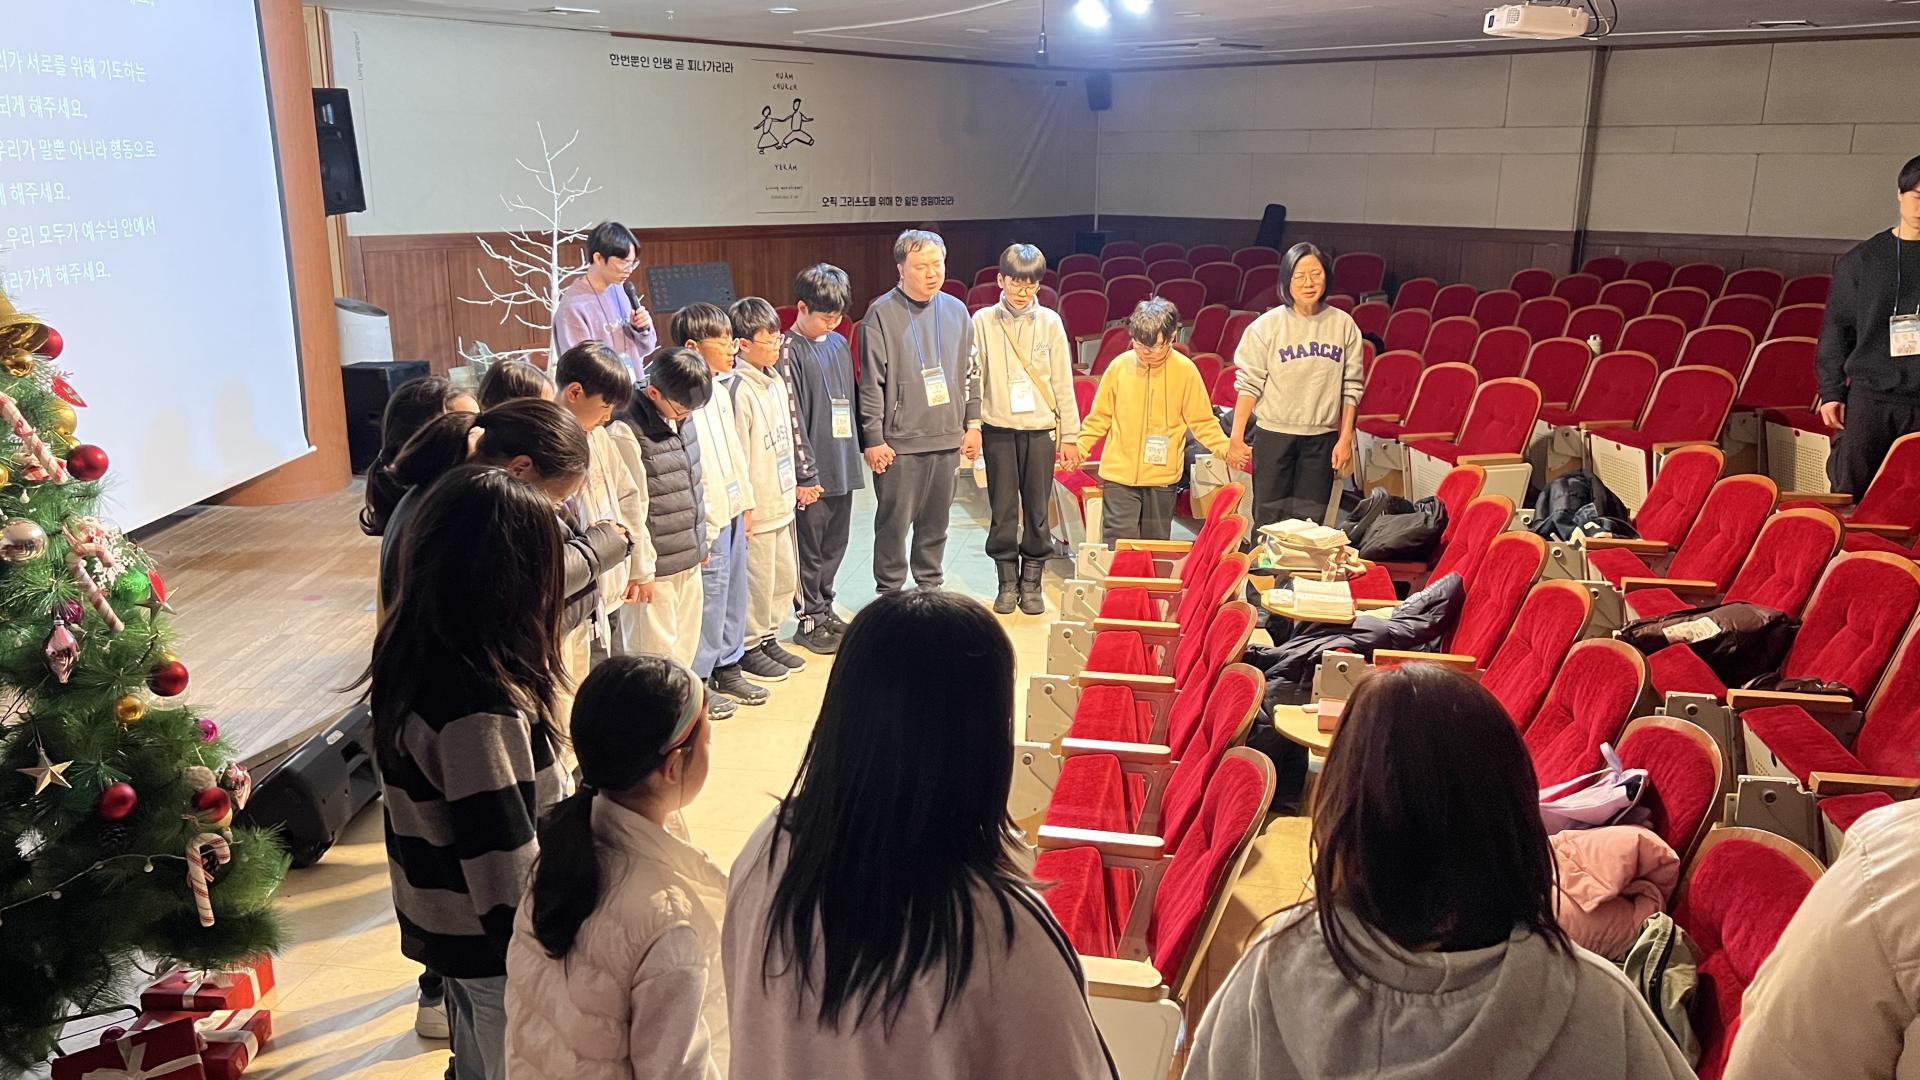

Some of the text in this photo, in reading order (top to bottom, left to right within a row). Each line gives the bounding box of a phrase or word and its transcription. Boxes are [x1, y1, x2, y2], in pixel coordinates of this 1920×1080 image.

[27, 52, 67, 77] 서로를
[70, 56, 97, 80] 위해
[100, 58, 148, 83] 기도하는
[28, 95, 88, 120] 해주세요.
[39, 138, 67, 161] 말뿐
[69, 138, 107, 161] 아니라
[110, 138, 157, 160] 행동으로
[9, 181, 71, 206] 해주세요.
[6, 215, 157, 249] 우리 모두가 예수님 안에서
[55, 260, 111, 285] 해주세요.
[1279, 341, 1343, 363] MARCH
